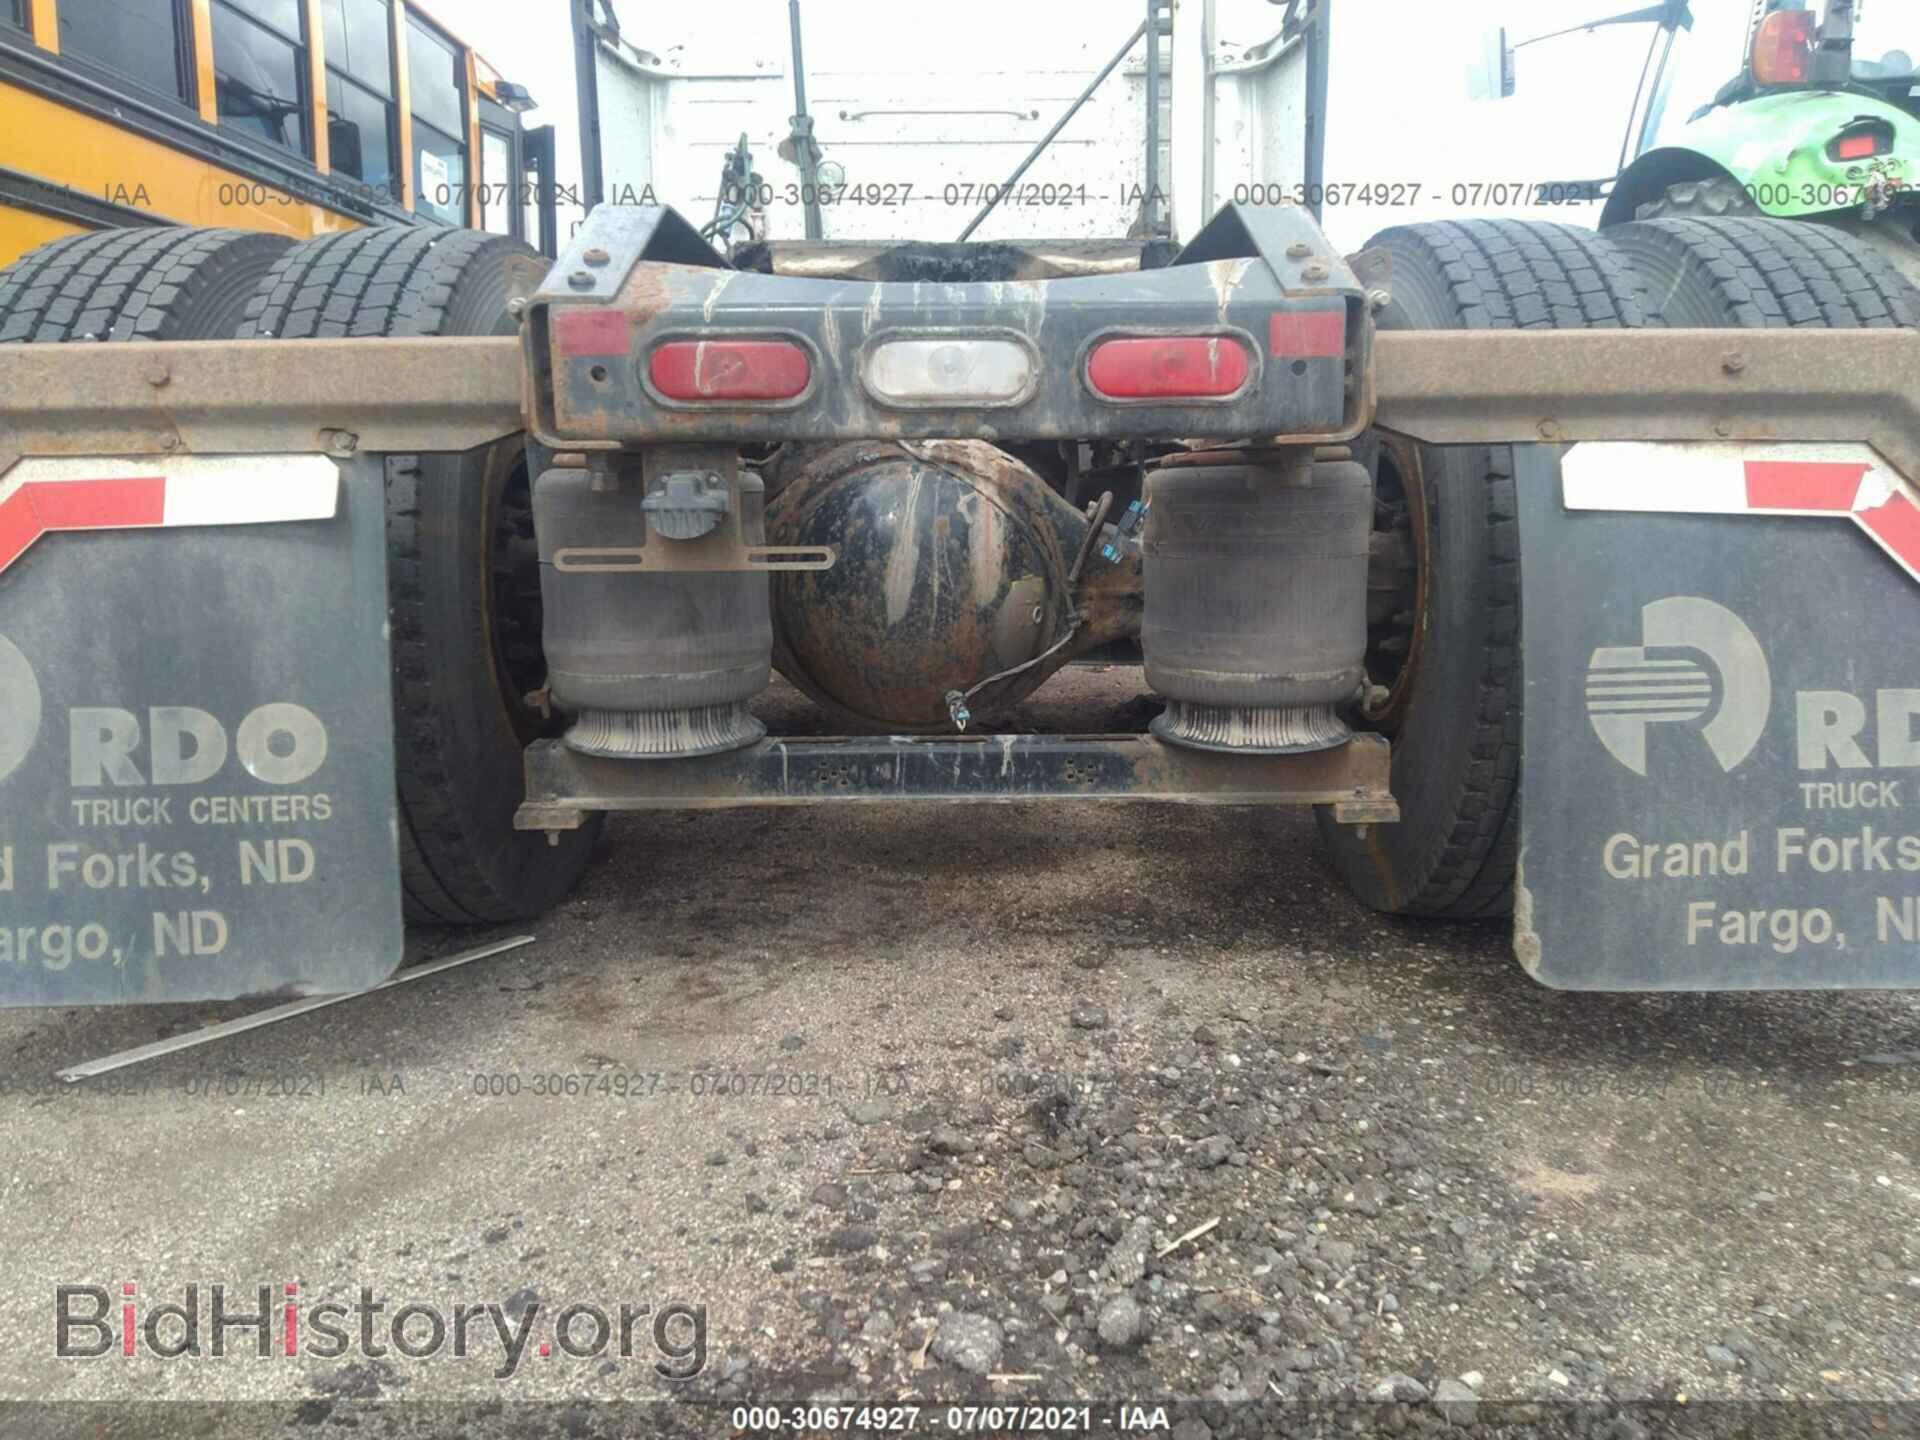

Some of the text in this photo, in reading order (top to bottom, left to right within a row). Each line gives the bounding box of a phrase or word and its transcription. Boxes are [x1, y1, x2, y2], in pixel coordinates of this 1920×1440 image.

[69, 702, 328, 786] RDO
[72, 793, 332, 827] TRUCK CENTERS
[1799, 780, 1900, 809] TRUCK
[47, 842, 209, 893] Forks,
[239, 838, 315, 885] ND
[1603, 829, 1749, 879] Grand
[153, 910, 228, 956] ND
[1687, 896, 1920, 953] Fargo, N
